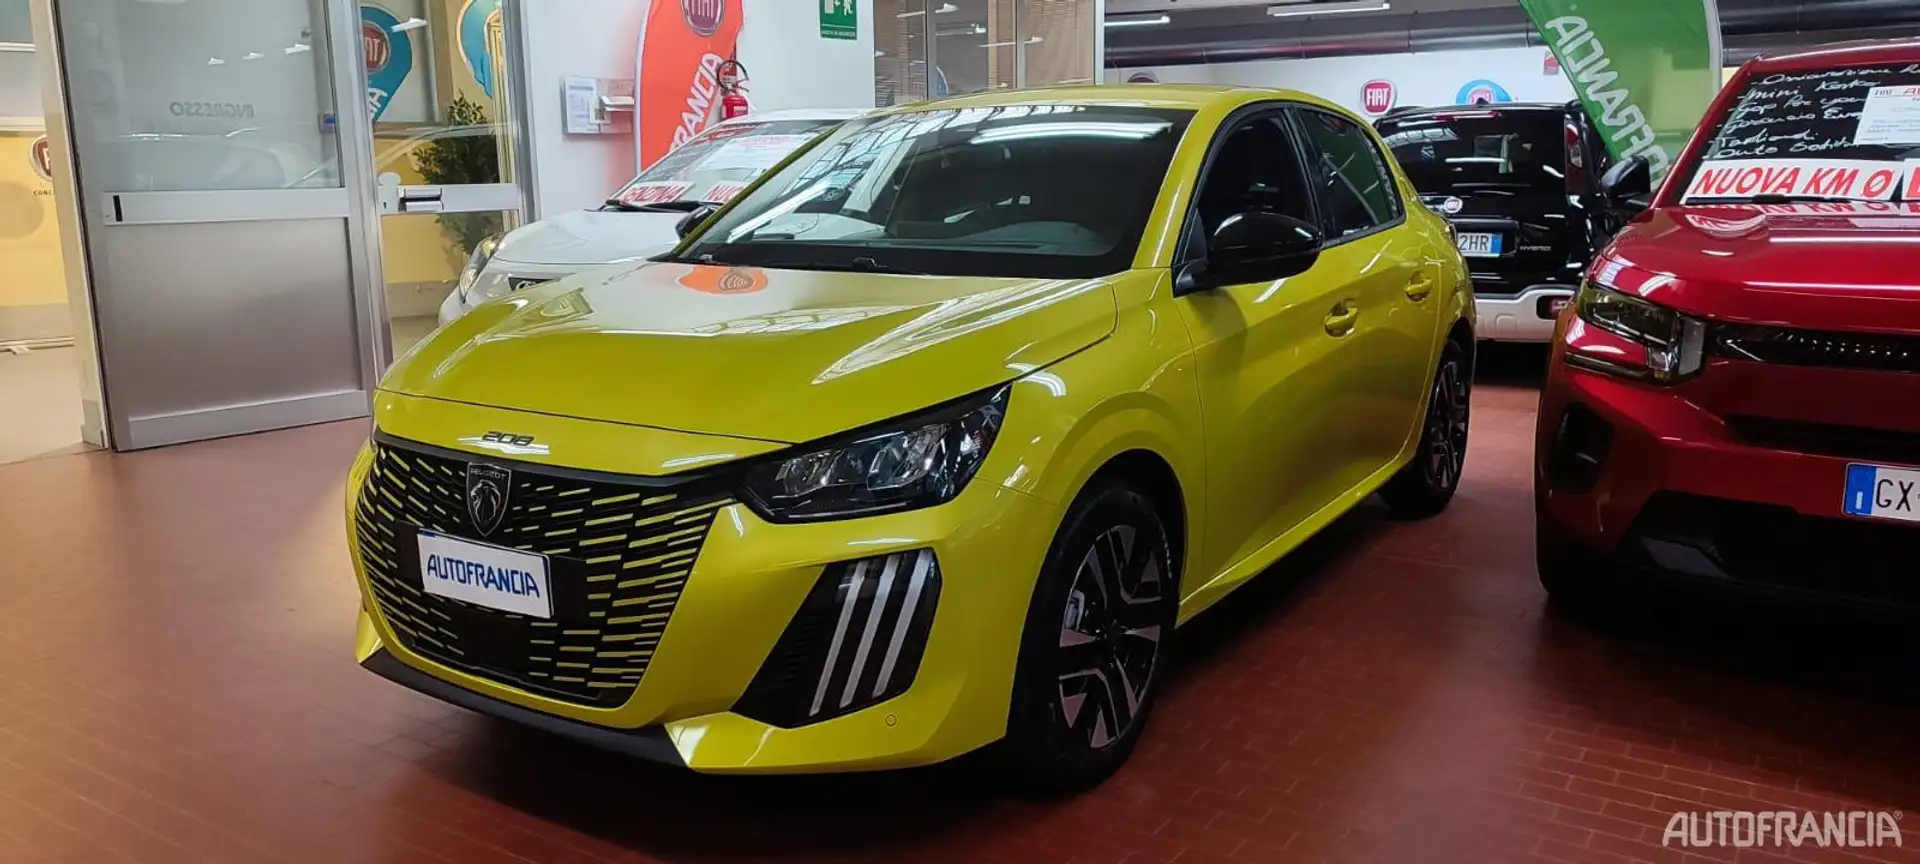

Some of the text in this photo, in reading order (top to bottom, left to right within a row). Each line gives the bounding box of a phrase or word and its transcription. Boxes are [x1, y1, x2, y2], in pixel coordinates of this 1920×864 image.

[1366, 89, 1389, 106] FIAT
[1693, 167, 1801, 195] NUOVA
[1803, 167, 1859, 196] KM
[1460, 235, 1489, 251] 2HR
[482, 431, 534, 447] 208
[1876, 478, 1915, 512] GX
[427, 554, 540, 598] AUTOFRANCIA
